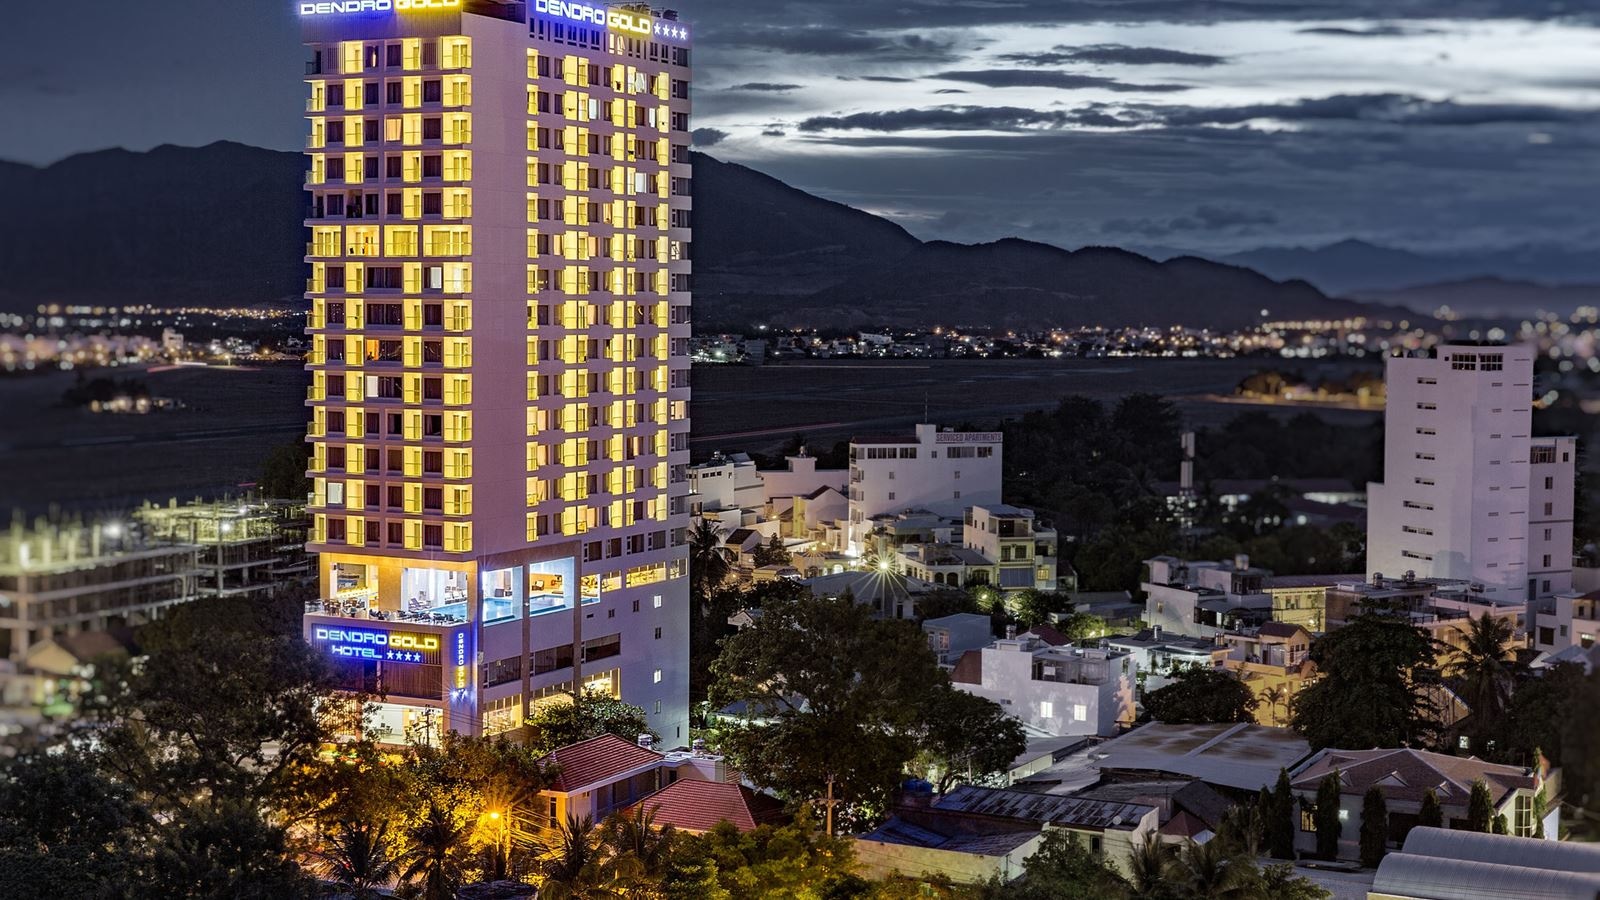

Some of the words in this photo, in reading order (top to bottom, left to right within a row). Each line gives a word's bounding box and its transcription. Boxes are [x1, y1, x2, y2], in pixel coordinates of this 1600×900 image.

[300, 0, 392, 15] DENDRO
[535, 0, 606, 26] DENDRO
[607, 12, 651, 35] GOLD
[936, 433, 963, 441] SERVICED
[964, 433, 1002, 441] APARTMENTS
[316, 628, 387, 645] DENDRO
[388, 635, 438, 650] GOLD
[331, 645, 383, 659] HOTEL
